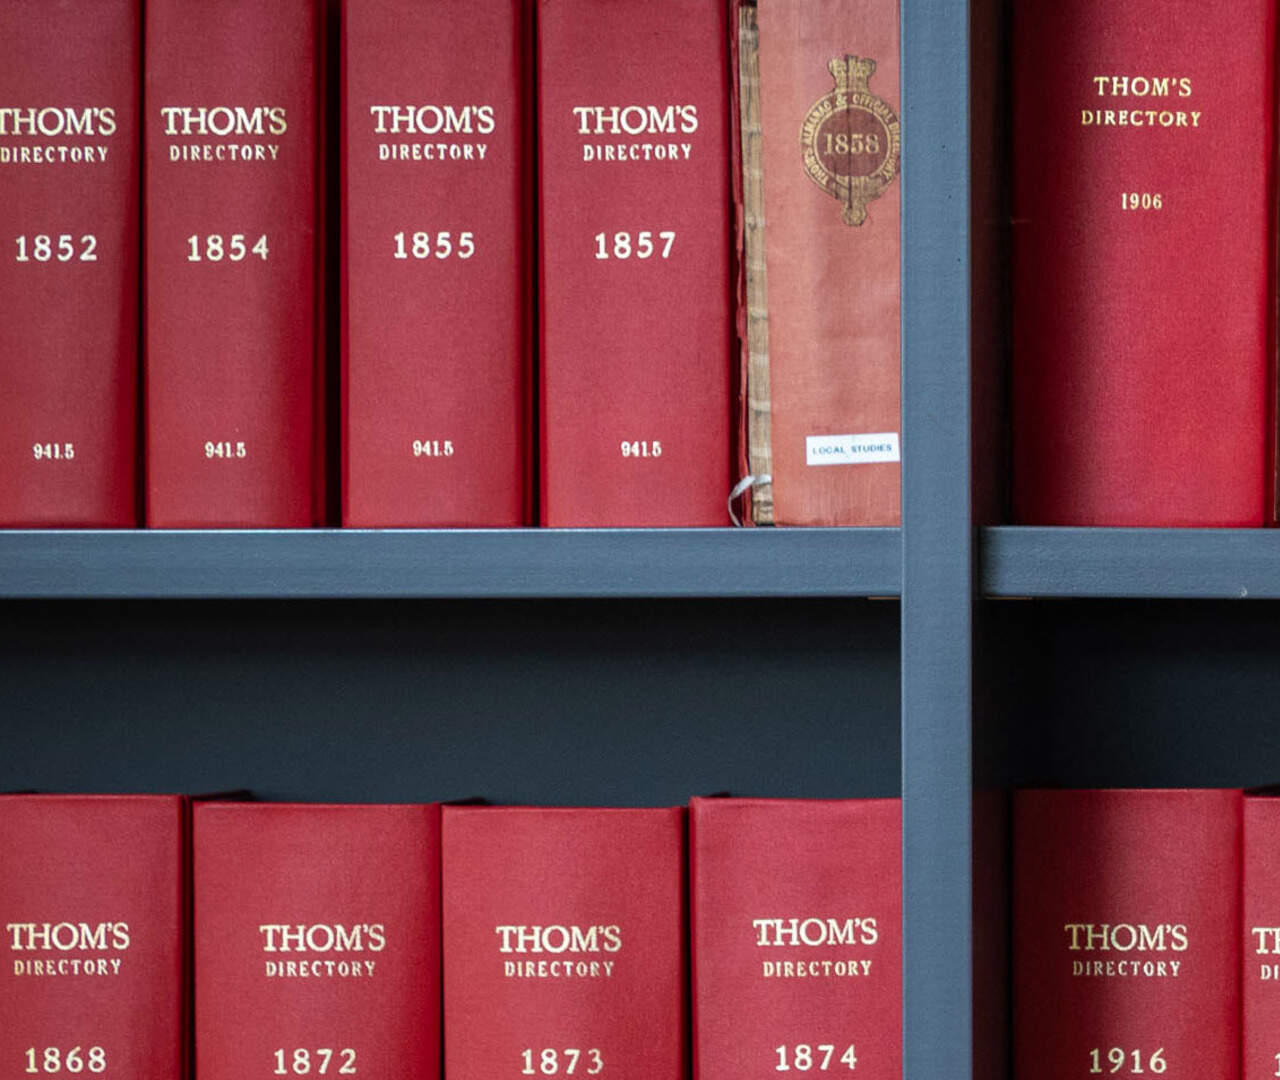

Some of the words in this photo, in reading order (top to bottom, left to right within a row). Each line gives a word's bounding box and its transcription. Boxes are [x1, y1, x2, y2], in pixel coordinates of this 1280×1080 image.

[1094, 77, 1191, 96] THOM'S
[0, 108, 116, 136] THOM'S
[161, 107, 286, 135] THOM'S
[371, 106, 494, 134] THOM'S
[573, 105, 698, 134] THOM'S
[1082, 110, 1200, 127] DIRECTORY
[1, 146, 107, 163] DIRECTORY
[170, 144, 278, 161] DIRECTORY
[379, 144, 486, 160] DIRECTORY
[584, 144, 691, 161] DIRECTORY
[822, 132, 880, 155] 1858
[1122, 193, 1162, 210] 1906
[16, 235, 96, 261] 1852
[188, 234, 268, 261] 1854
[394, 232, 474, 258] 1855
[596, 232, 675, 259] 1857
[33, 443, 74, 459] 941.5
[205, 442, 246, 458] 941.5
[413, 440, 453, 456] 941.5
[621, 441, 661, 457] 941.5
[811, 443, 846, 456] LOCAL
[850, 441, 893, 454] STUDIES
[7, 922, 129, 950] THOM'S
[260, 924, 385, 952] THOM'S
[496, 925, 621, 953] THOM'S
[753, 918, 878, 946] THOM'S
[1066, 924, 1188, 951] THOM'S
[15, 959, 120, 975] DIRECTORY
[266, 960, 375, 977] DIRECTORY
[505, 961, 613, 977] DIRECTORY
[763, 960, 871, 977] DIRECTORY
[1074, 960, 1181, 977] DIRECTORY
[26, 1046, 106, 1073] 1868
[274, 1048, 356, 1074] 1872
[522, 1049, 603, 1075] 1873
[776, 1044, 857, 1071] 1874
[1091, 1048, 1167, 1073] 1916
